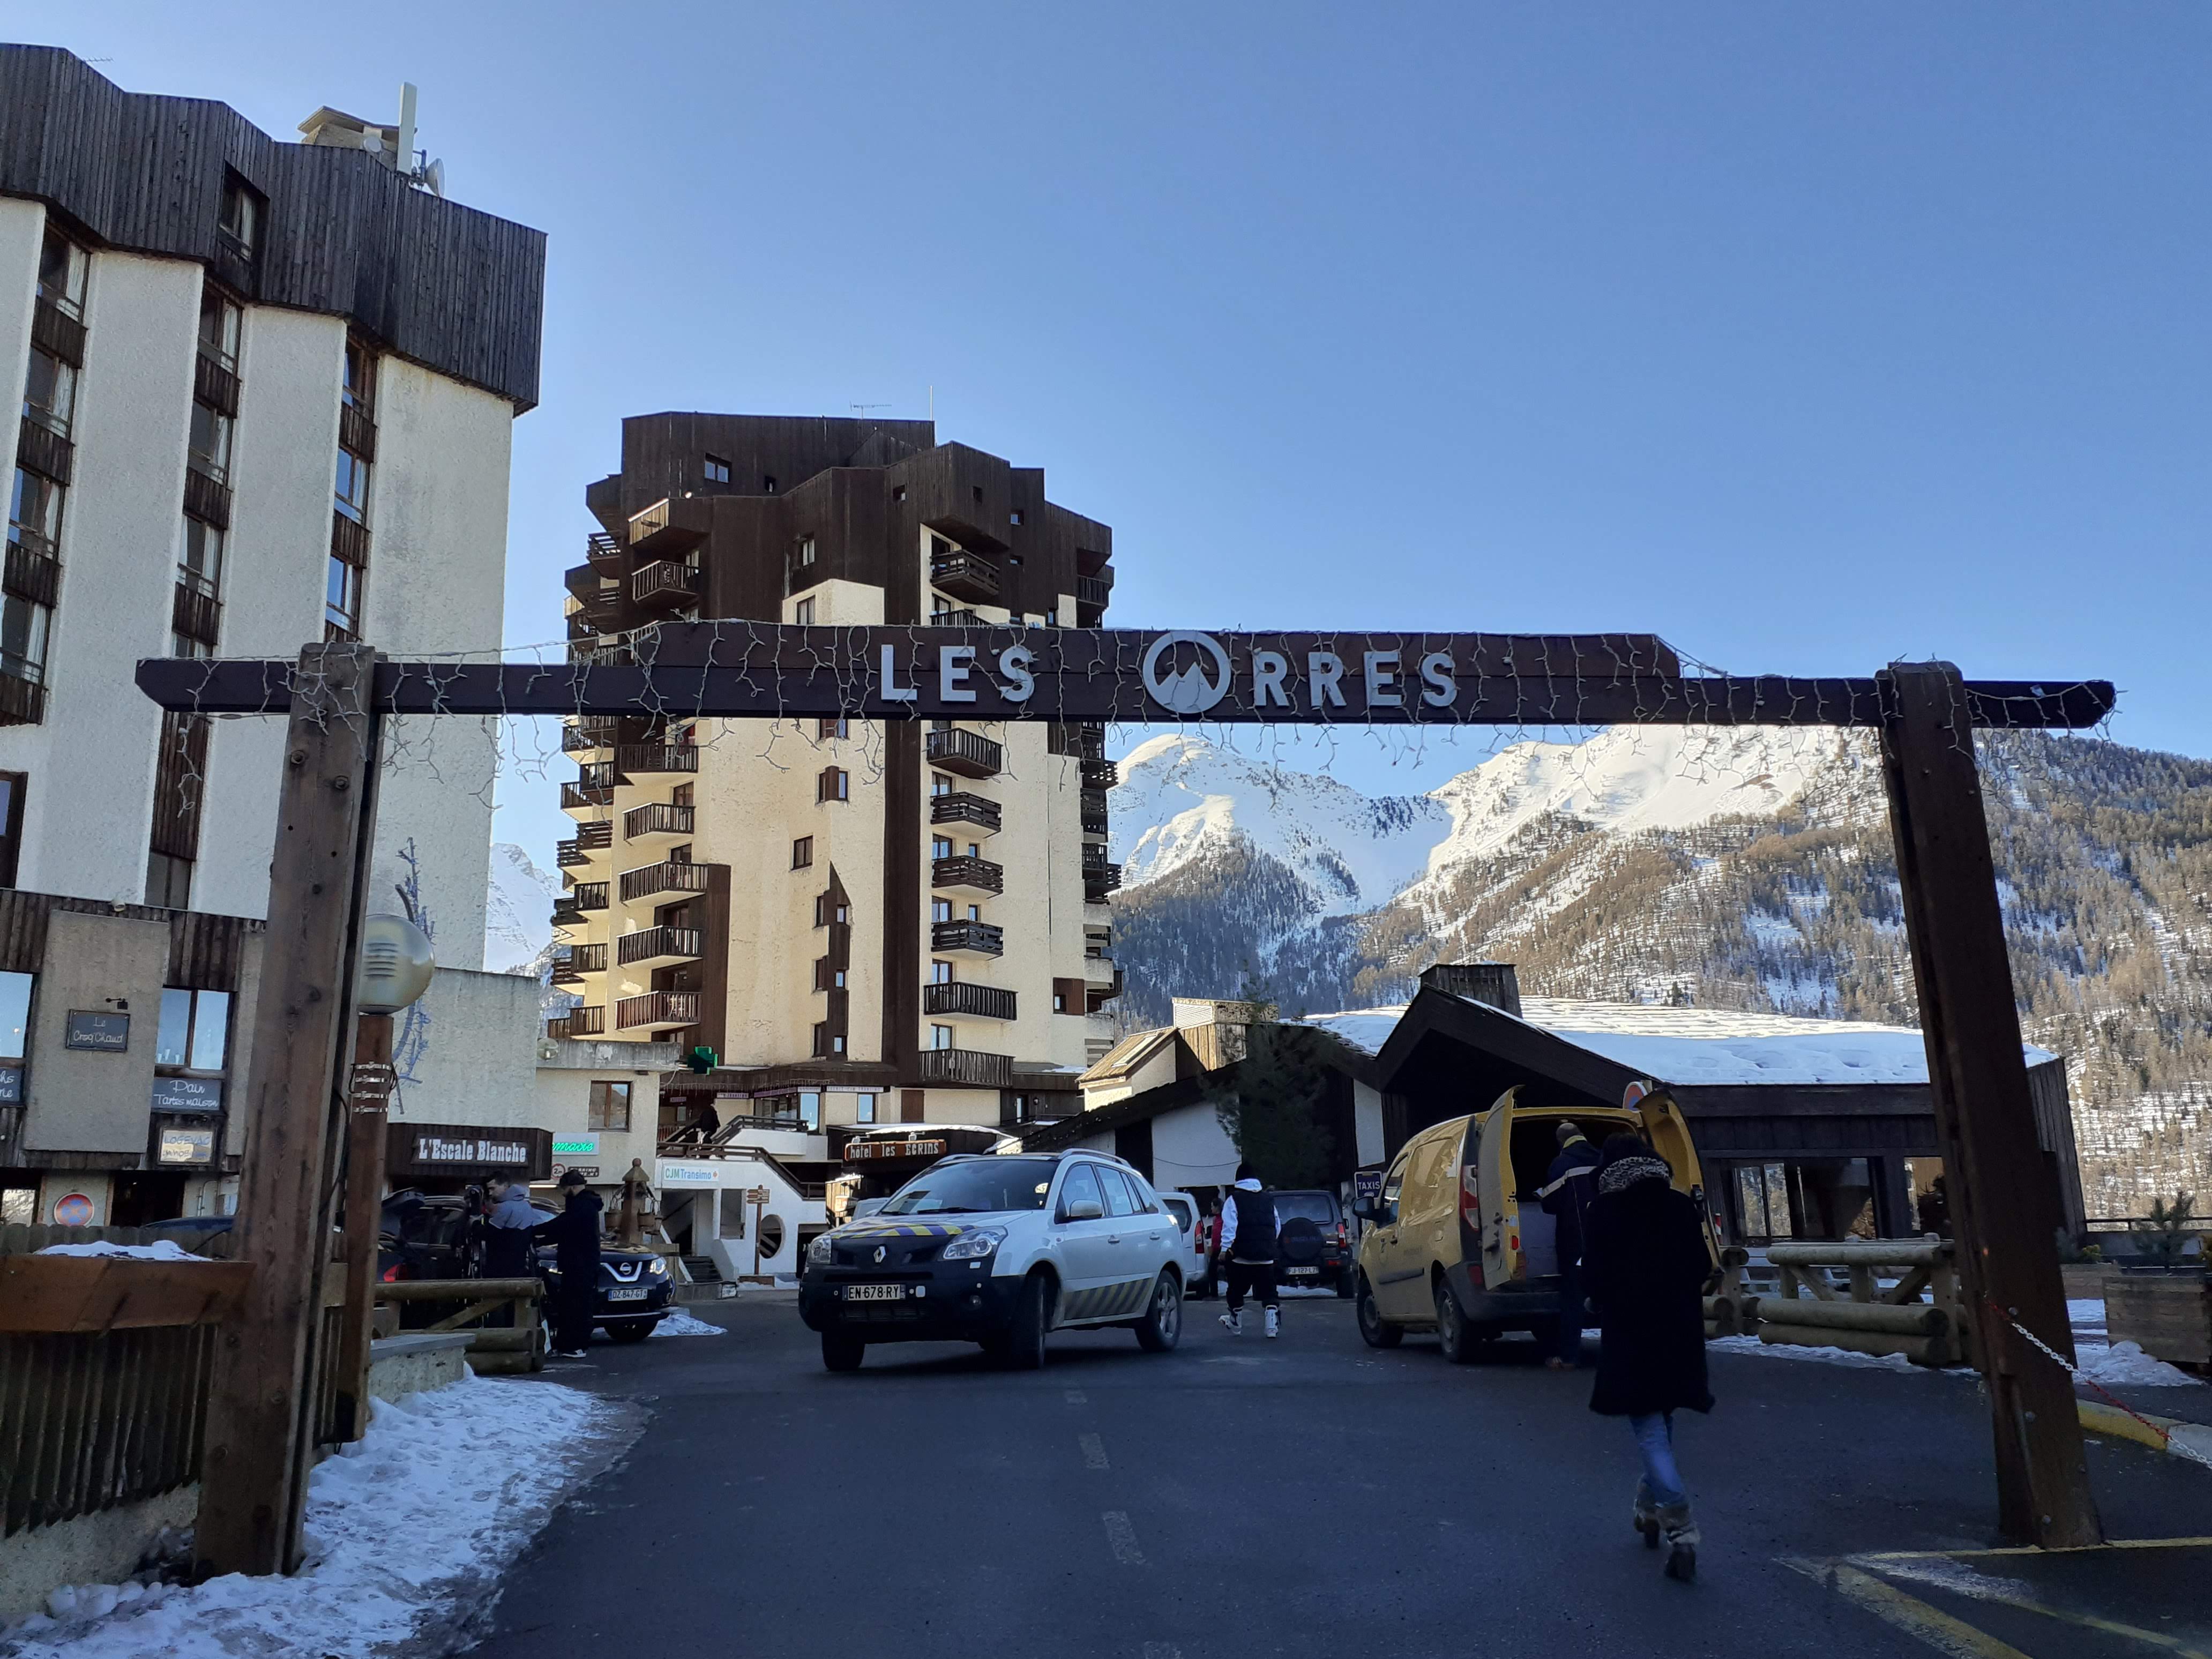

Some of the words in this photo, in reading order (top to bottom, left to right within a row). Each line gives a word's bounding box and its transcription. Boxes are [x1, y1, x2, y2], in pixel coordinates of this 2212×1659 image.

[879, 642, 1035, 703] LES
[169, 1079, 206, 1094] Pain
[153, 1094, 185, 1105] Tartes
[419, 1138, 474, 1160] L'Escale
[476, 1140, 526, 1163] Blanche
[850, 1144, 872, 1159] hôtel
[881, 1144, 895, 1157] les
[665, 1168, 679, 1179] CJM
[680, 1168, 712, 1179] Transimo
[1357, 1180, 1380, 1190] TAXIS
[848, 1286, 899, 1299] EN-678-RY
